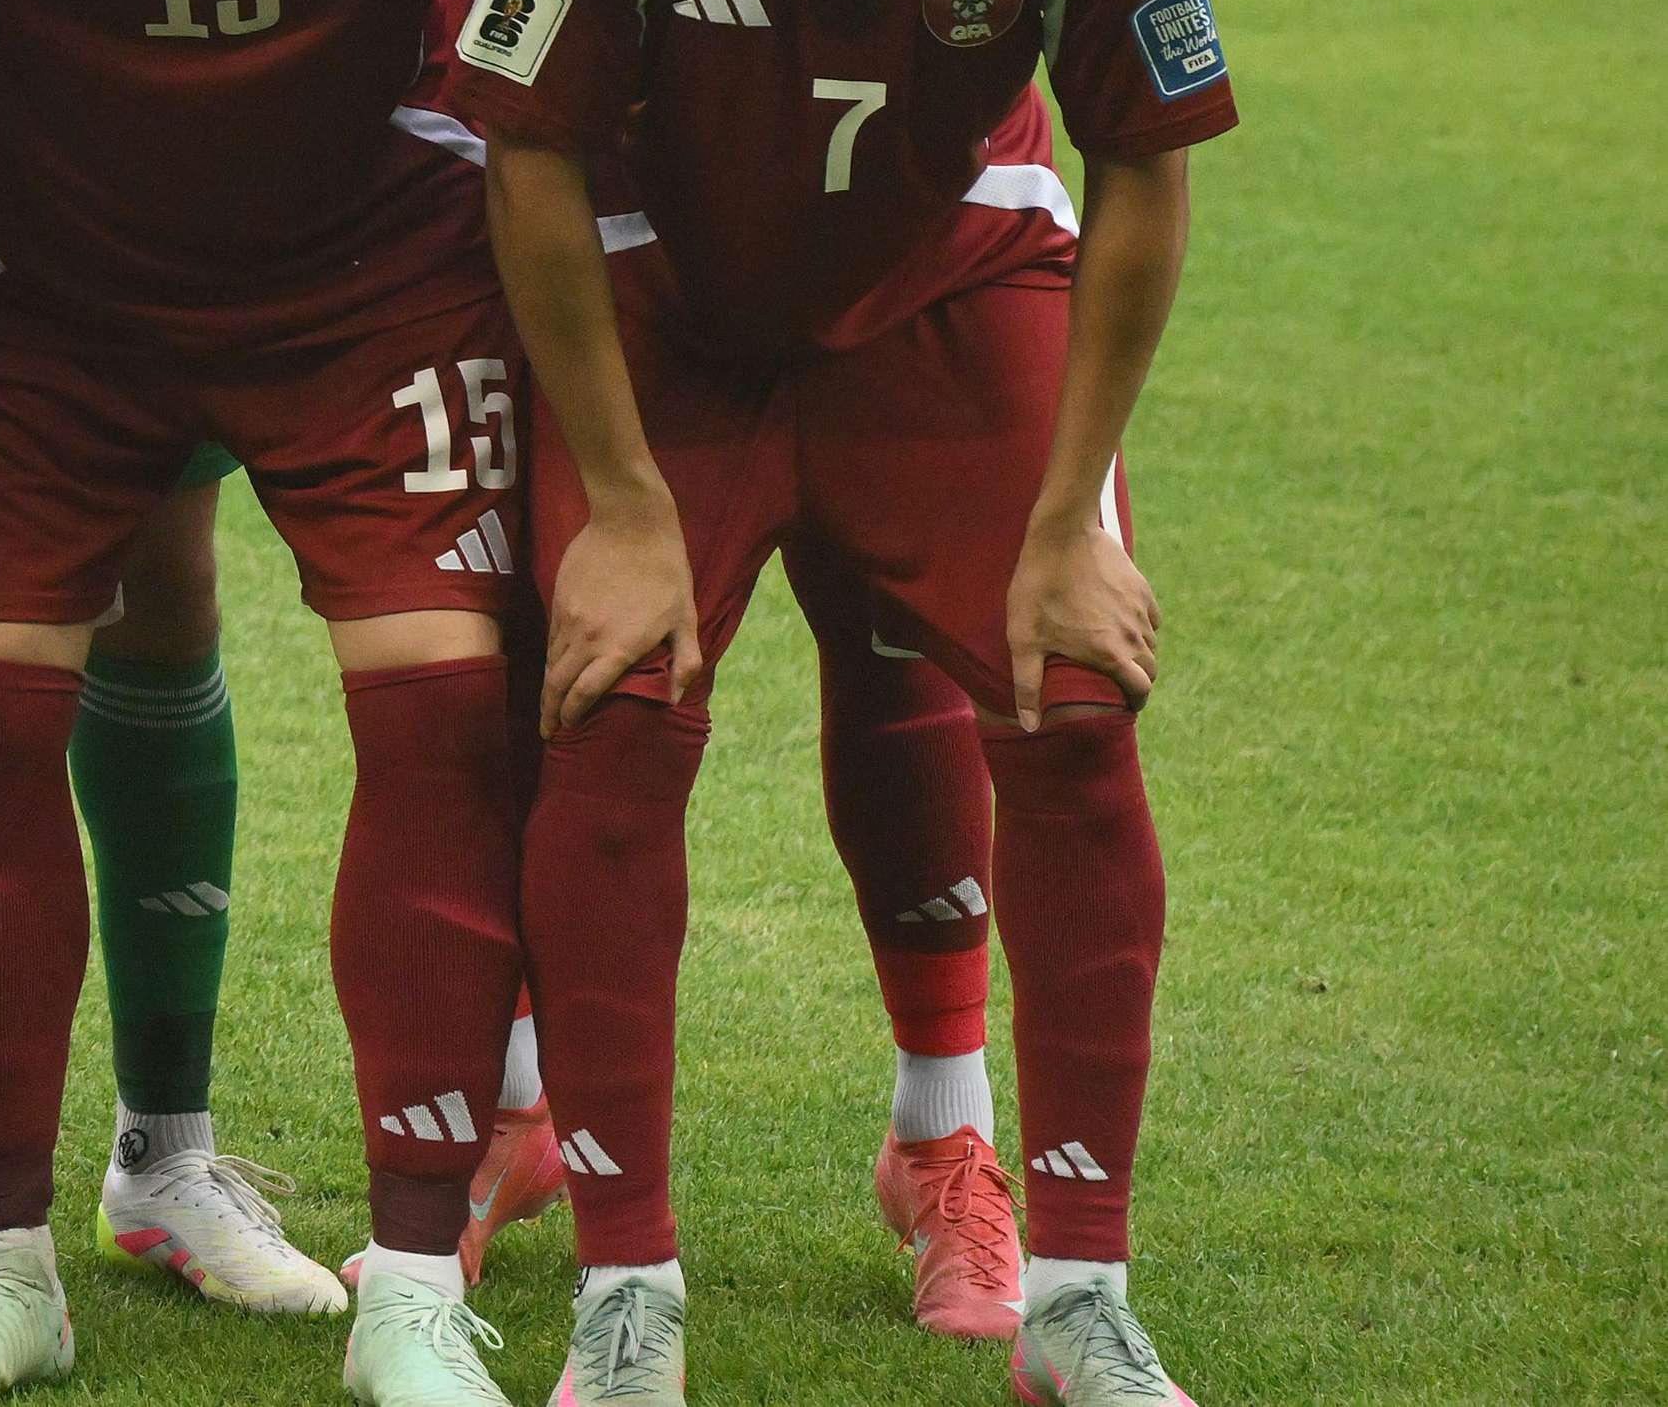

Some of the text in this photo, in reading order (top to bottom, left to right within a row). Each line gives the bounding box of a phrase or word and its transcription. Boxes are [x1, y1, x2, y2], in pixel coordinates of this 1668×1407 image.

[950, 23, 992, 41] QFA
[1155, 7, 1211, 44] UNITES
[1160, 42, 1185, 62] the
[1188, 54, 1211, 69] FIFA
[812, 78, 888, 194] 7
[392, 357, 518, 493] 15
